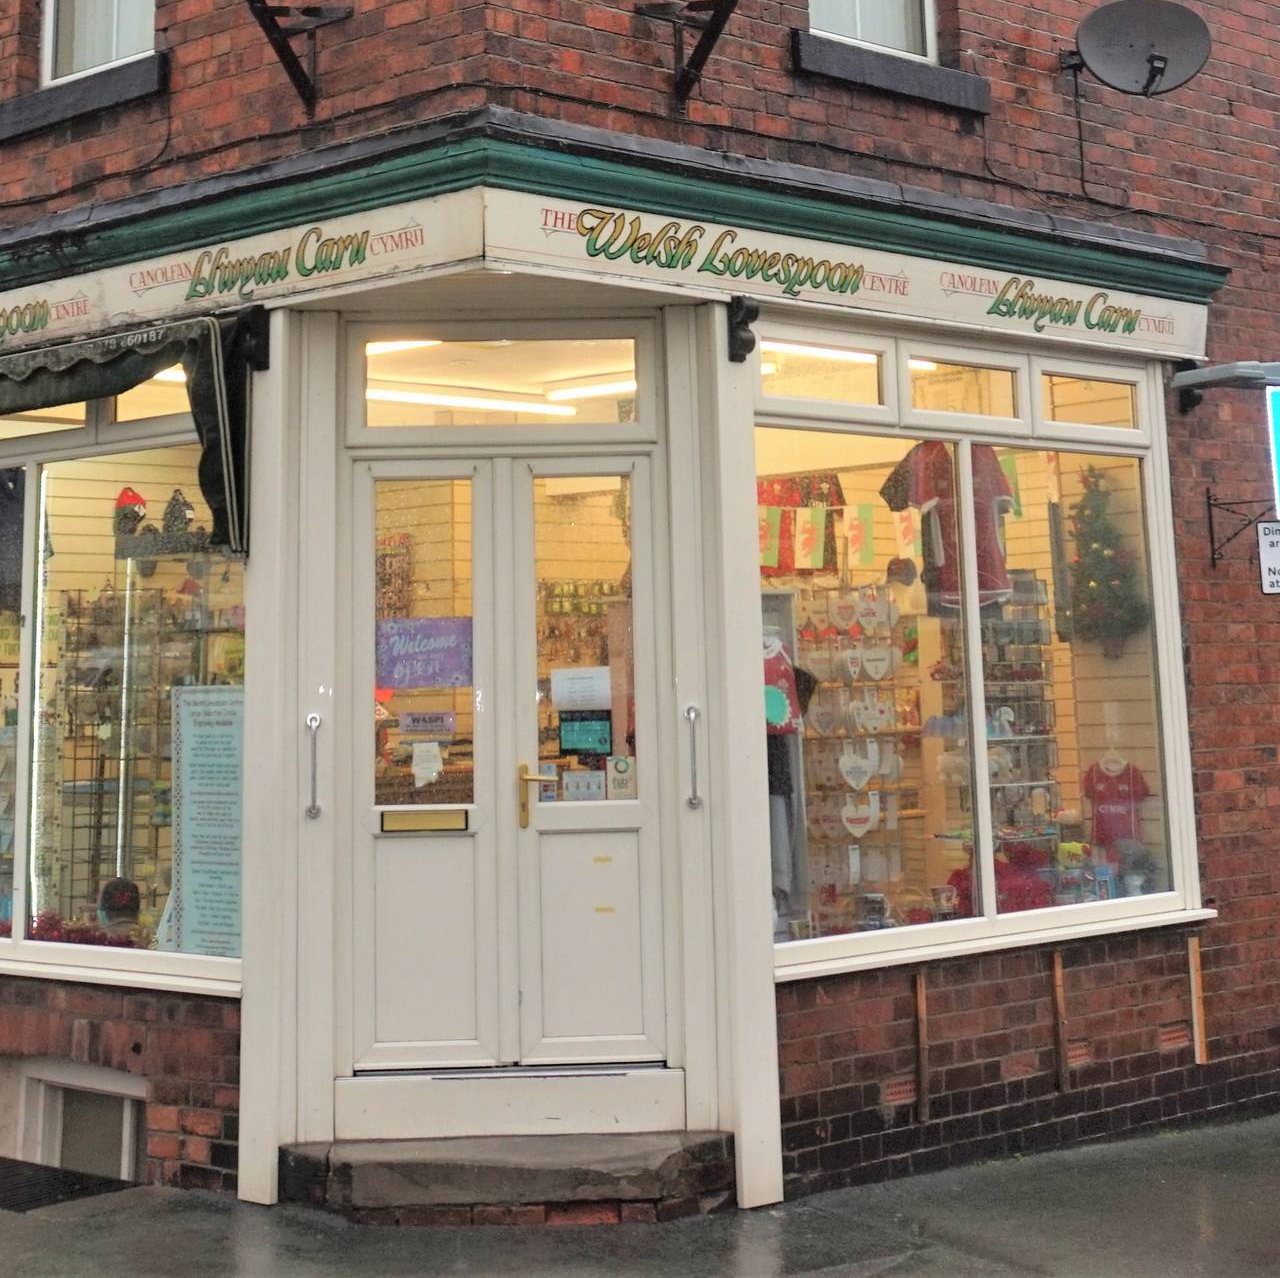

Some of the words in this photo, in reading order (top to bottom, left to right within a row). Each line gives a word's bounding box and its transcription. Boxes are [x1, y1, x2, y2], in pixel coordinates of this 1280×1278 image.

[129, 261, 194, 290] CANOLFAN
[184, 246, 293, 302] Llwyau
[295, 226, 370, 278] Caru
[369, 226, 425, 257] CYMRU
[540, 208, 577, 232] THE
[576, 208, 706, 271] Welsh
[697, 229, 866, 297] Lovespoon
[863, 273, 910, 297] CENTRE
[48, 298, 90, 323] CENTRE
[939, 271, 1000, 296] CANOLFAN
[986, 276, 1083, 333] Llwyau
[1084, 292, 1142, 335] Caru
[1138, 315, 1175, 336] CYMRU
[1269, 540, 1280, 548] ar
[1269, 579, 1280, 589] at
[390, 633, 457, 657] Welcome
